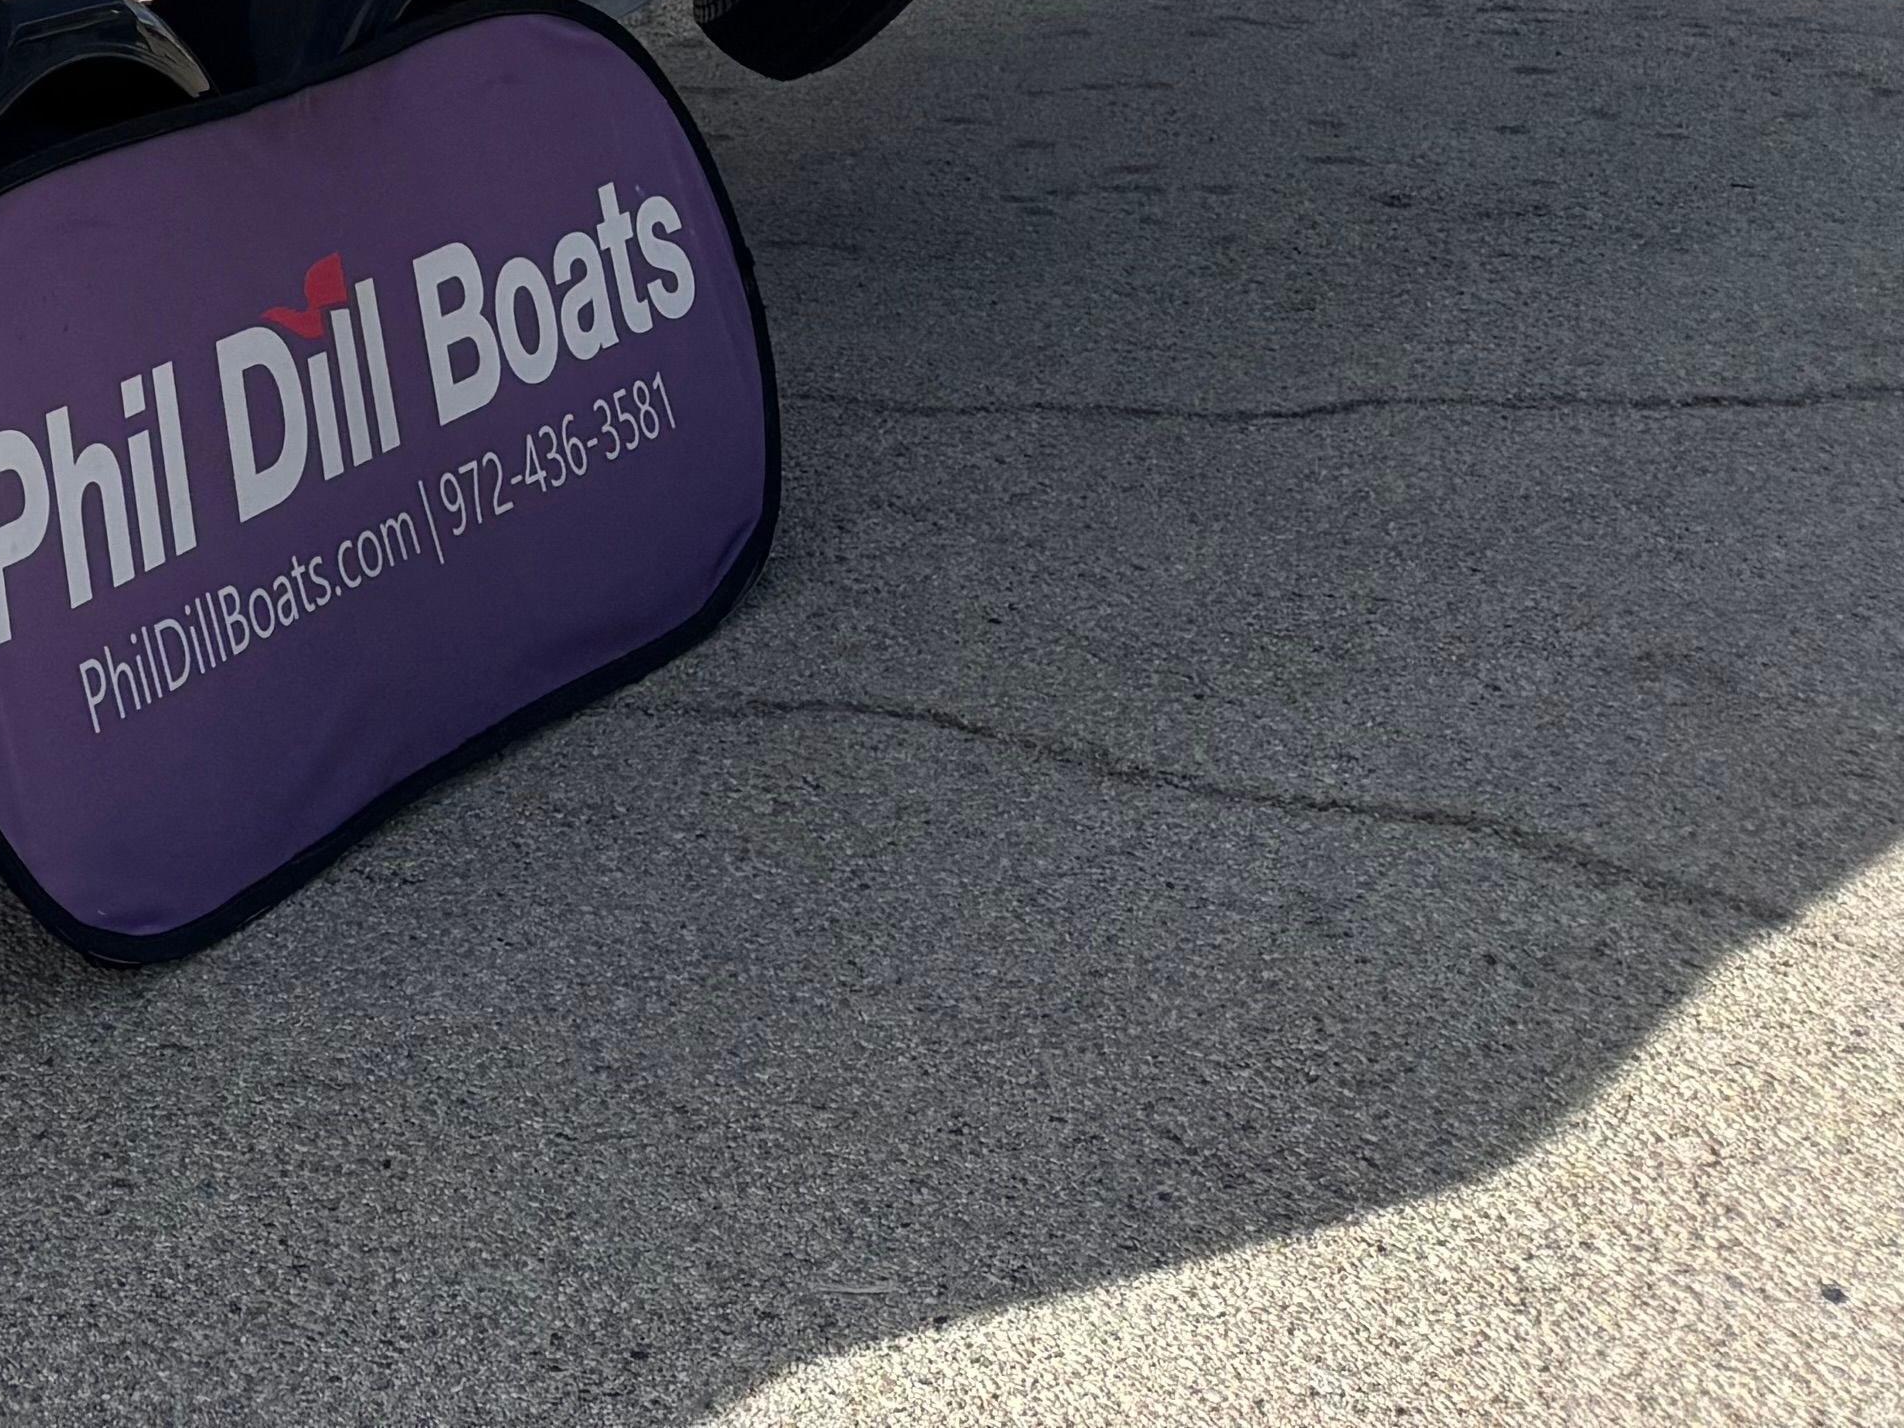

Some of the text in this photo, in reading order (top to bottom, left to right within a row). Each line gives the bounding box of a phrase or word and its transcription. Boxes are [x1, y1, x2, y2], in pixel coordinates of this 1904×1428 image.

[215, 275, 401, 523] Dill
[412, 181, 697, 427] Boats
[79, 511, 422, 735] PhilDillBoats.com
[439, 372, 677, 537] 972-436-3581
